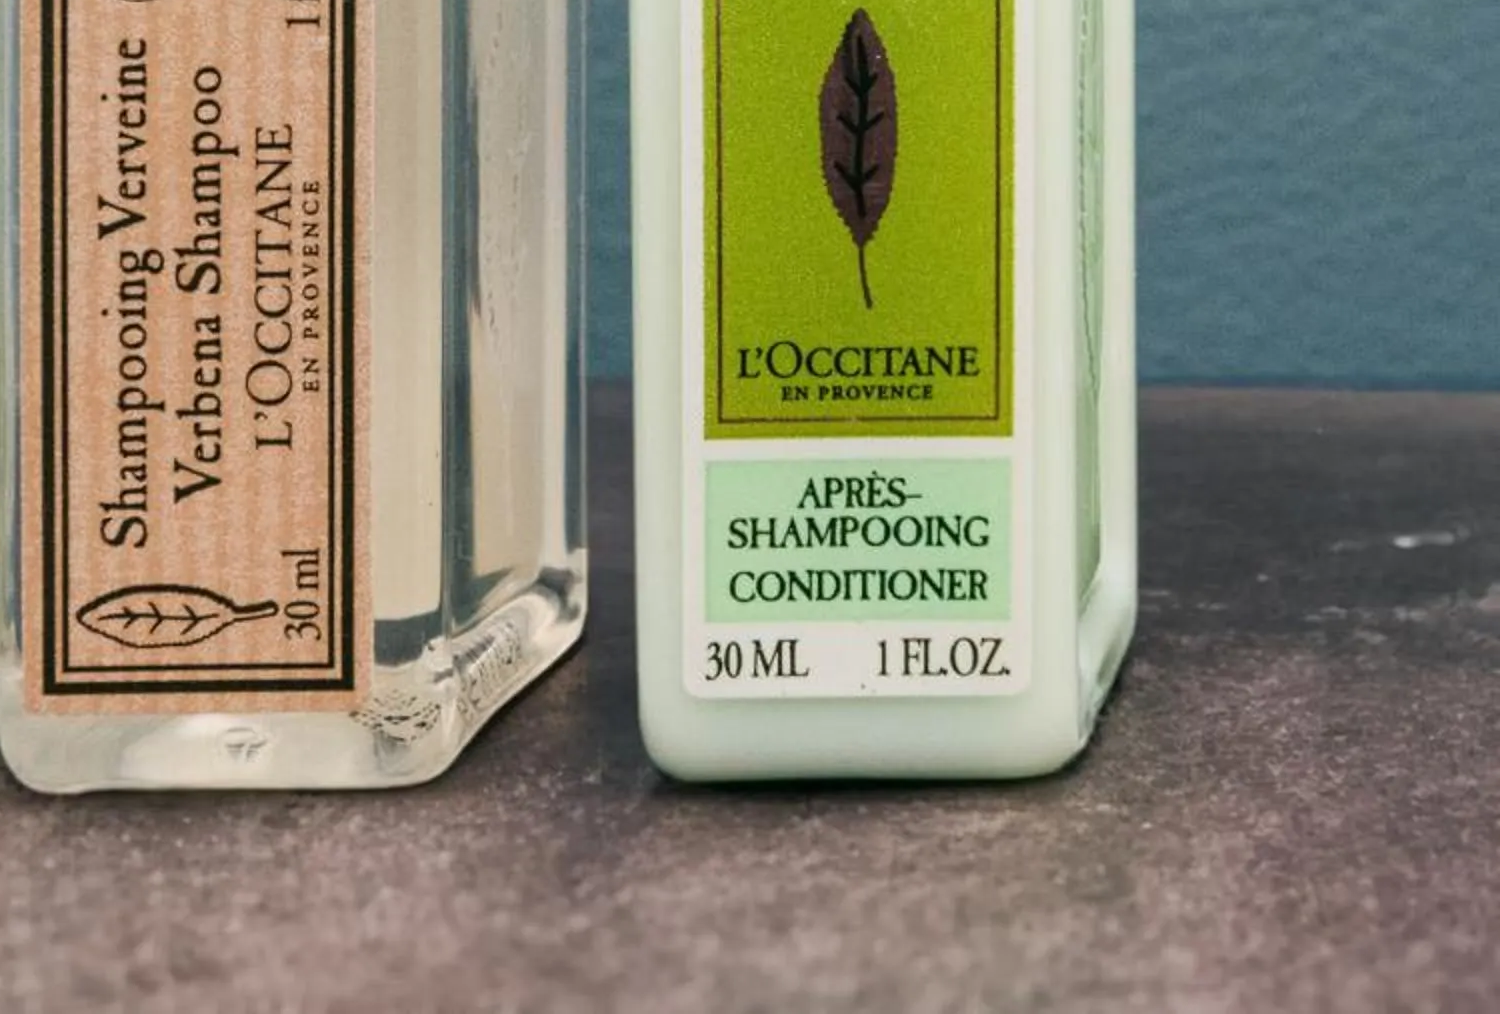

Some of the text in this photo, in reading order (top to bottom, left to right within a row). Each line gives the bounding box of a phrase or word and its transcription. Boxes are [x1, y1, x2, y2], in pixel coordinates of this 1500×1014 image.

[284, 15, 321, 29] 1
[97, 37, 166, 550] Shampooing Verveine
[173, 66, 241, 505] Verbena Shampoo
[244, 123, 294, 451] L'OCCITANE
[301, 180, 321, 393] EN PROVENCE
[738, 340, 981, 380] L'OCCITANE
[781, 384, 934, 402] EN PROVENCE
[727, 514, 990, 549] SHAMPOOING
[280, 547, 322, 642] 30 ml
[729, 568, 989, 603] CONDITIONER
[704, 639, 810, 681] 30 ML
[877, 640, 890, 677] 1
